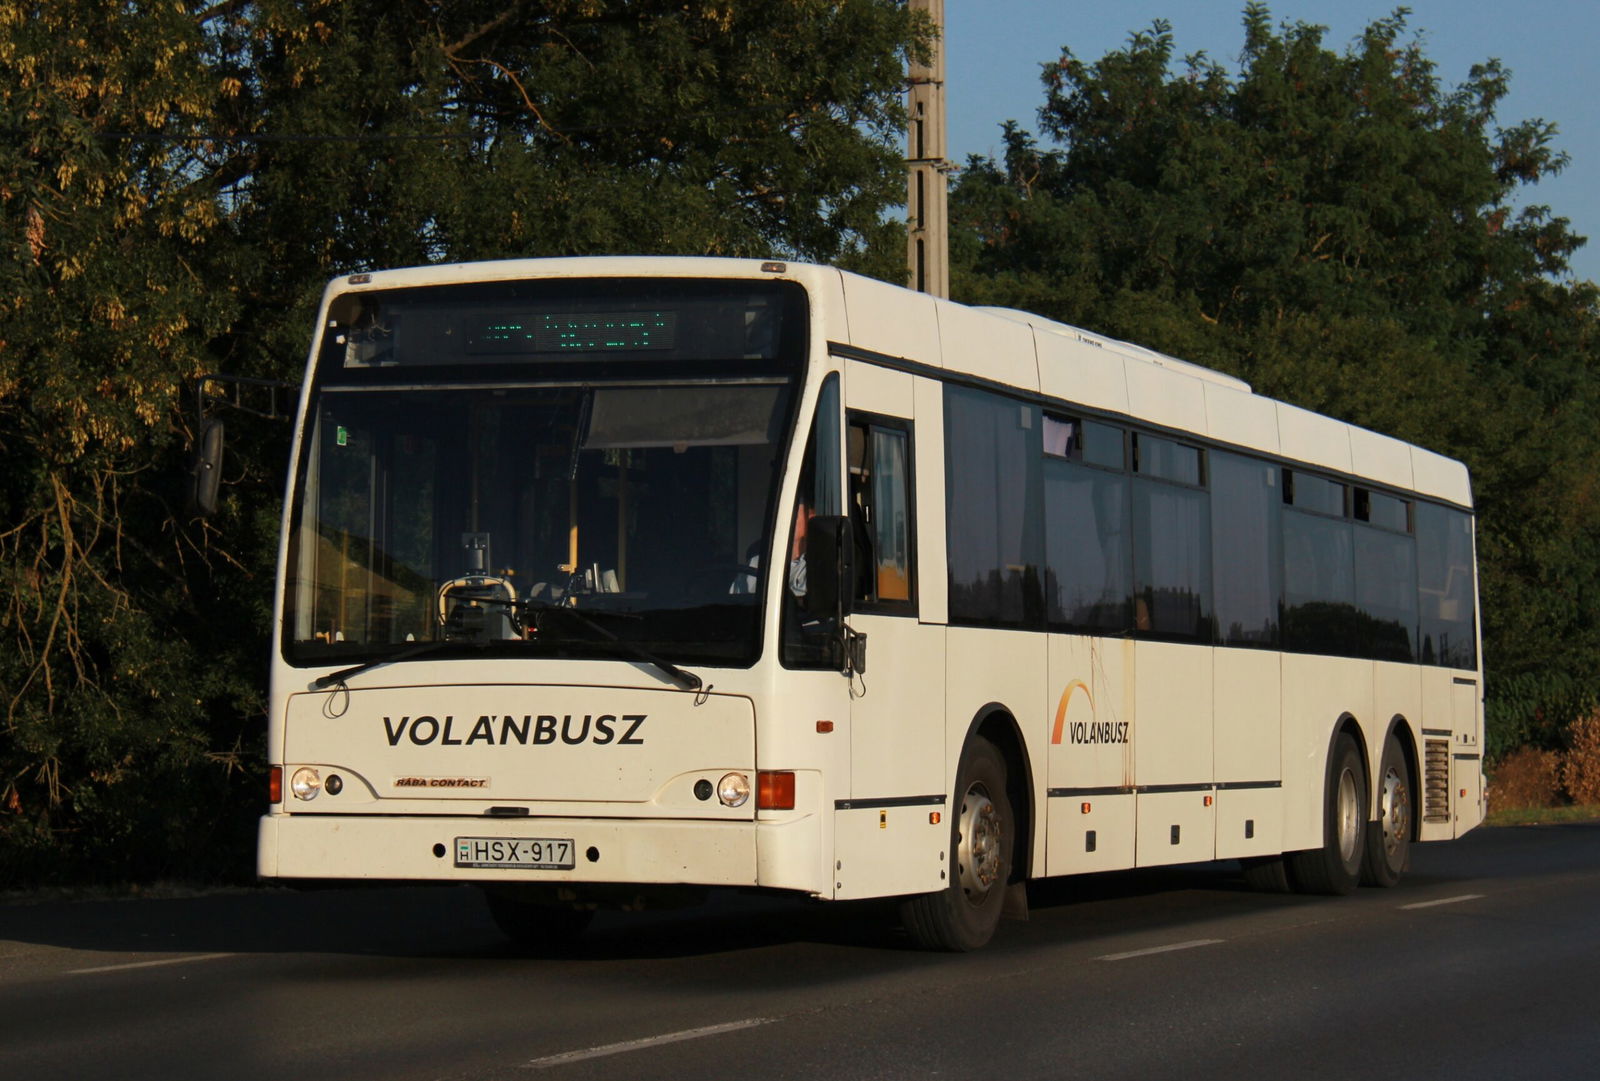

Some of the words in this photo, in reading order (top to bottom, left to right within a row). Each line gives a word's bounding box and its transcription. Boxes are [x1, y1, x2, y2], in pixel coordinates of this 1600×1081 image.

[383, 714, 648, 746] VOLÁNBUSZ
[1070, 721, 1129, 744] VOLÁNBUSZ
[396, 777, 427, 787] RÁBA
[430, 779, 486, 788] CONTACT
[475, 841, 568, 863] HSX-917
